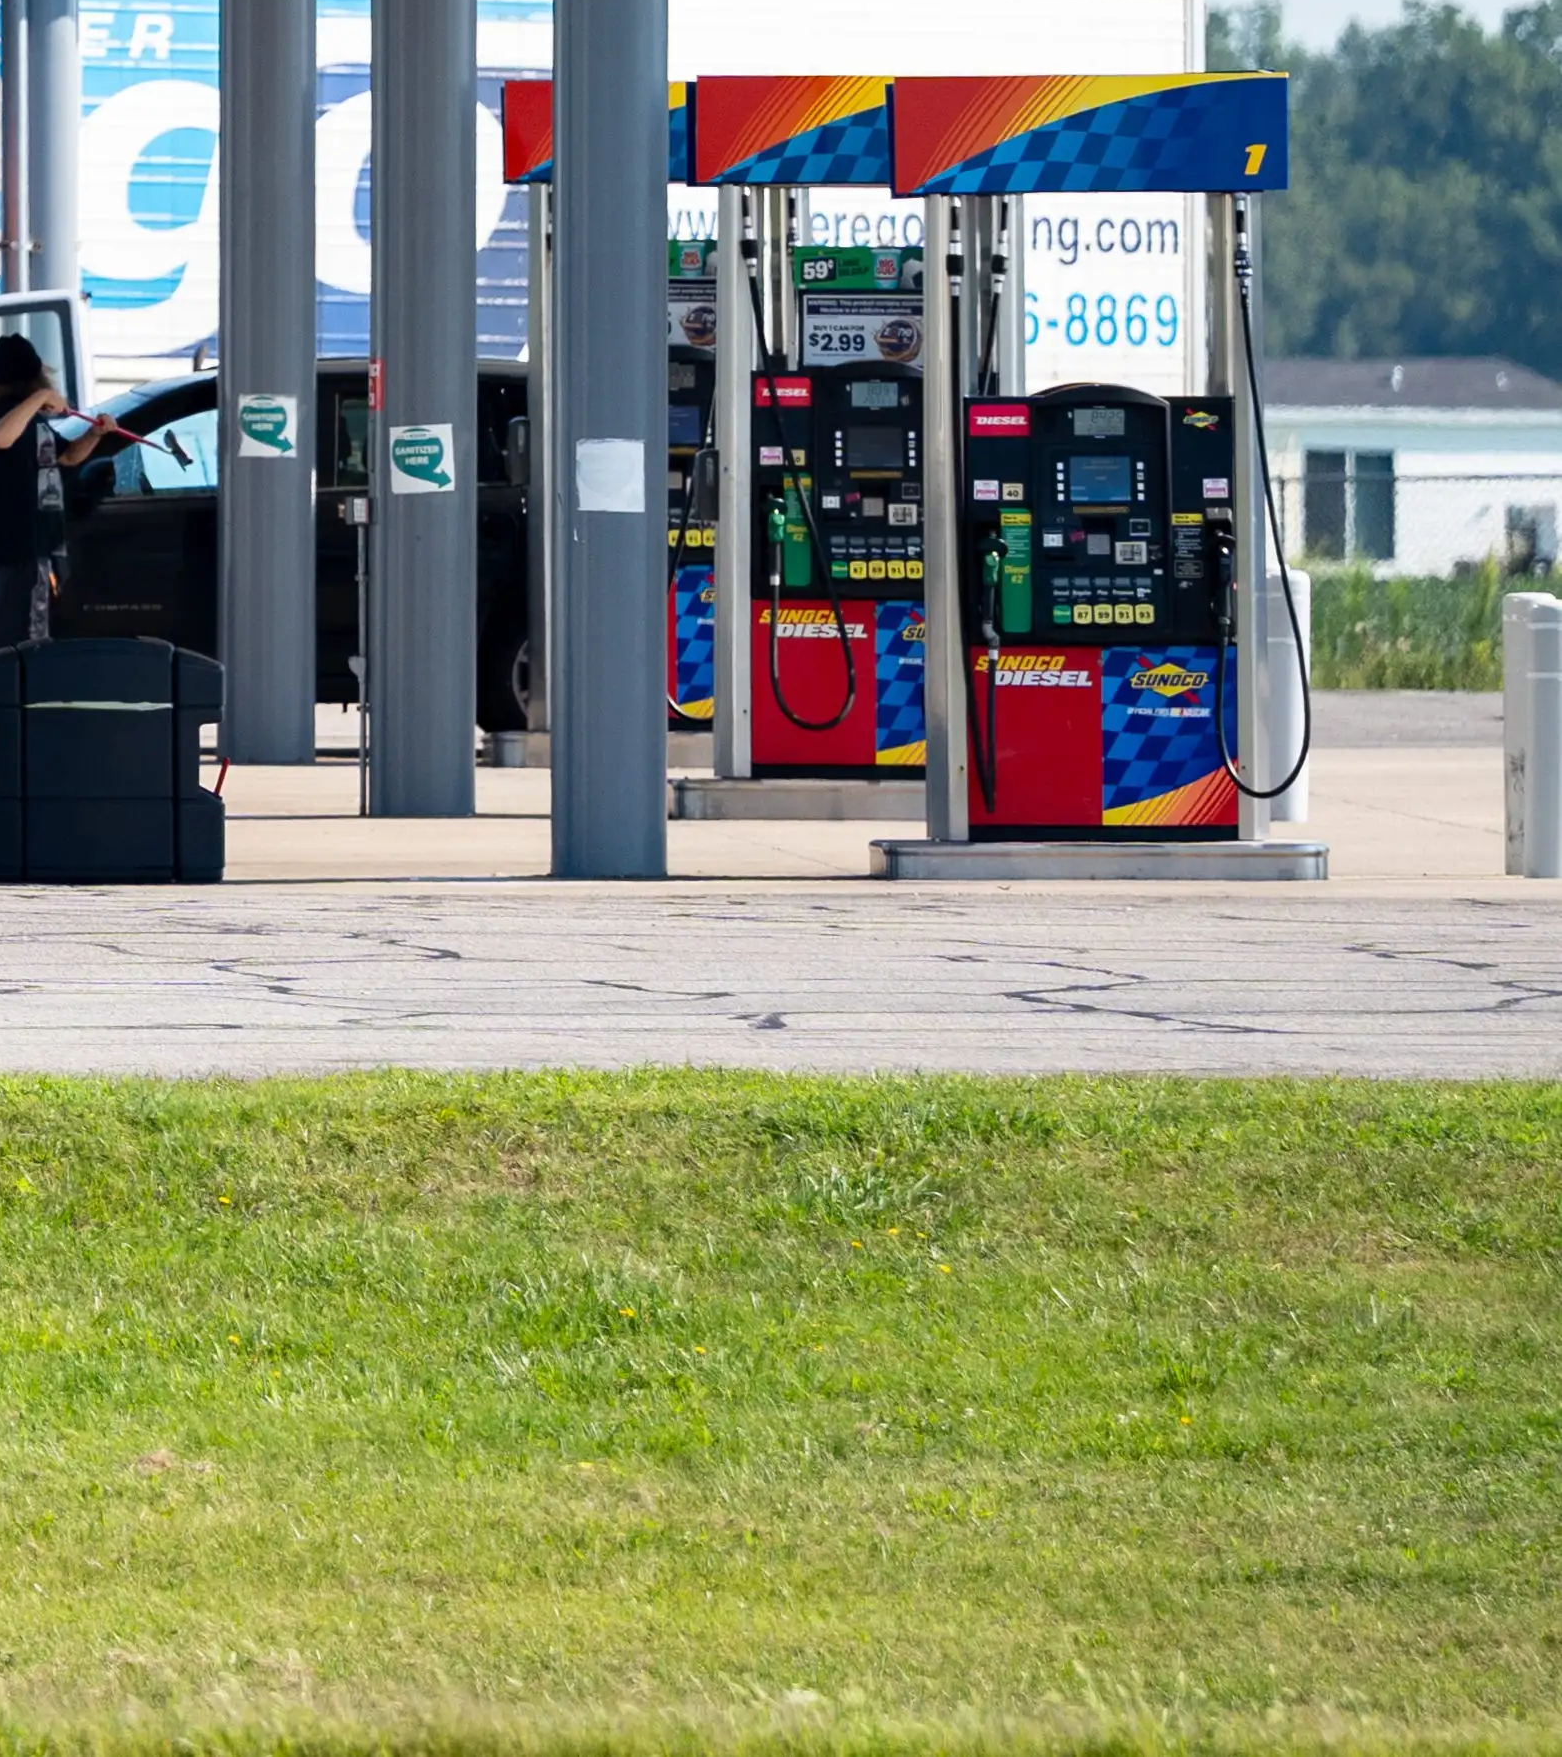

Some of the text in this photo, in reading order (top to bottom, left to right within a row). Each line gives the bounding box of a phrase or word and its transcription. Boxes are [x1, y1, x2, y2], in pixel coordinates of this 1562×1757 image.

[1244, 144, 1267, 176] 1
[808, 333, 866, 352] $2.99
[975, 416, 1028, 426] DIESEL
[1006, 488, 1019, 498] 40
[994, 670, 1093, 686] DIESEL
[1134, 673, 1206, 687] SUNOCO
